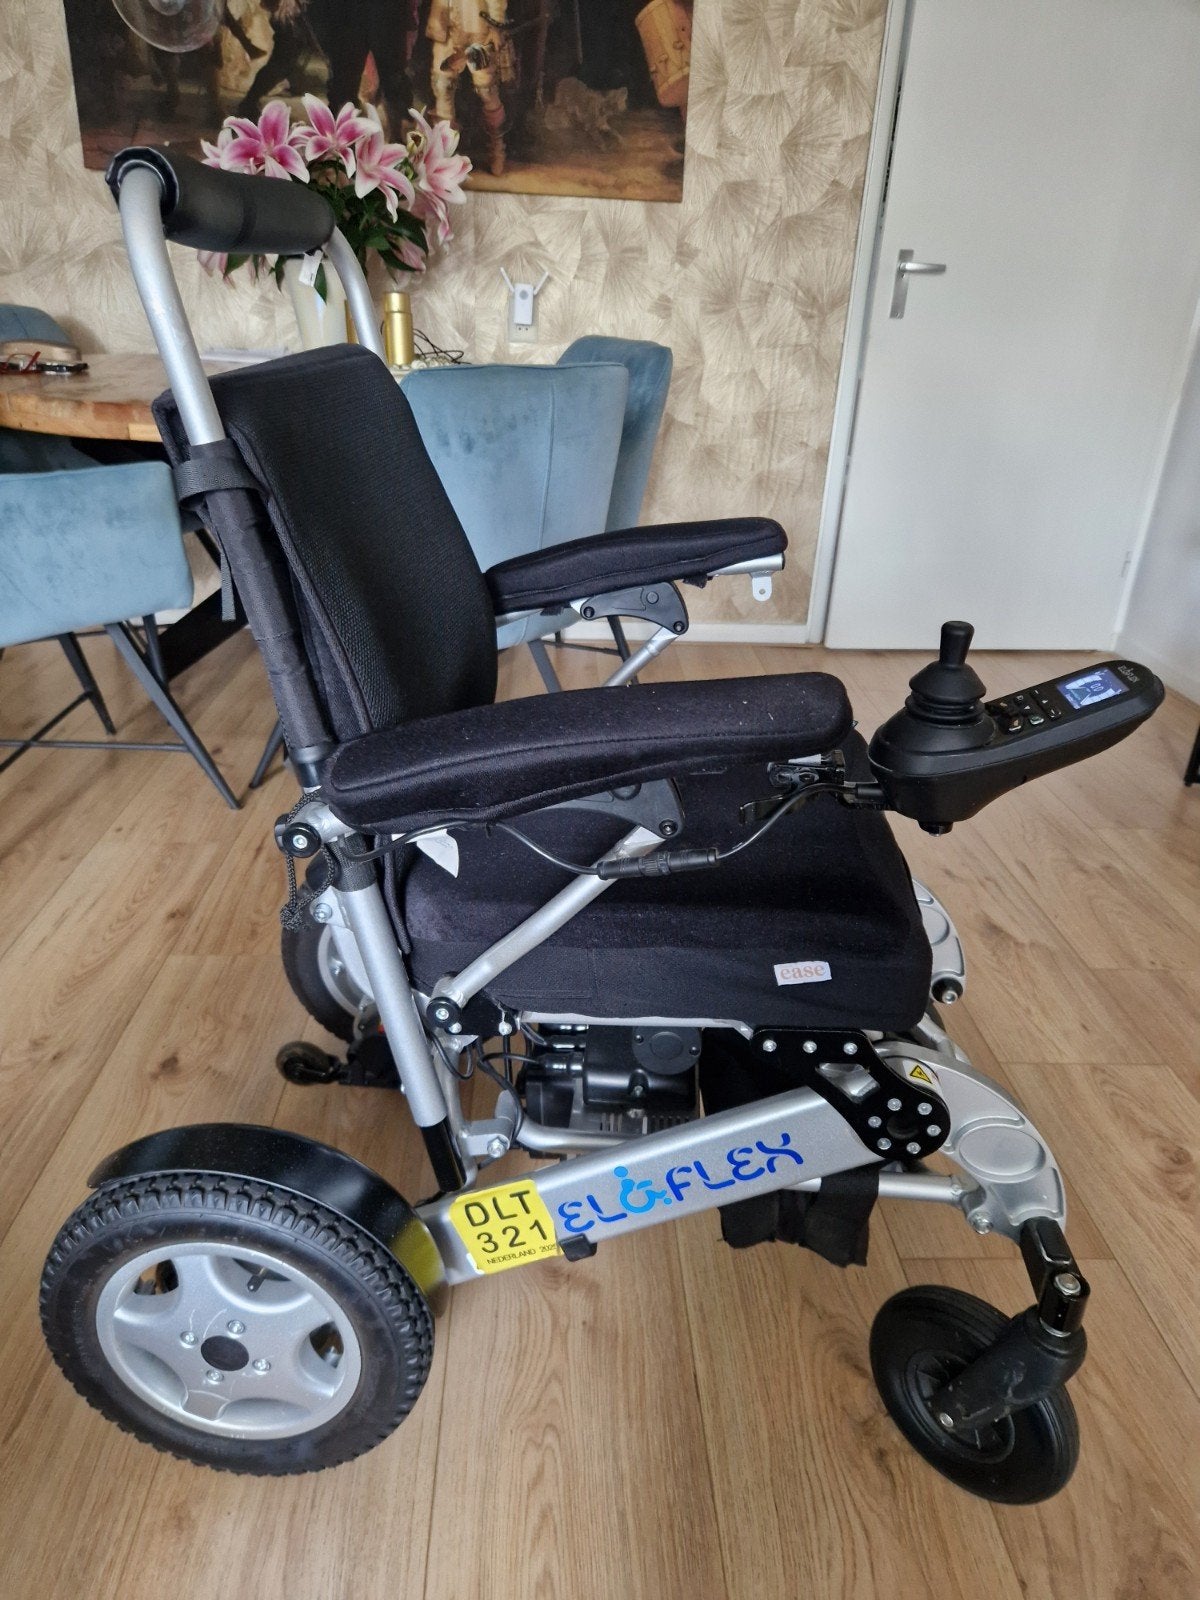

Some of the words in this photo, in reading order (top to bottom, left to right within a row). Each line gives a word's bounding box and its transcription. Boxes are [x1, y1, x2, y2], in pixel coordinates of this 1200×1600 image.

[781, 965, 825, 979] ease
[465, 1190, 530, 1227] DLT
[477, 1219, 547, 1254] 321
[486, 1248, 536, 1265] NEDERLAND
